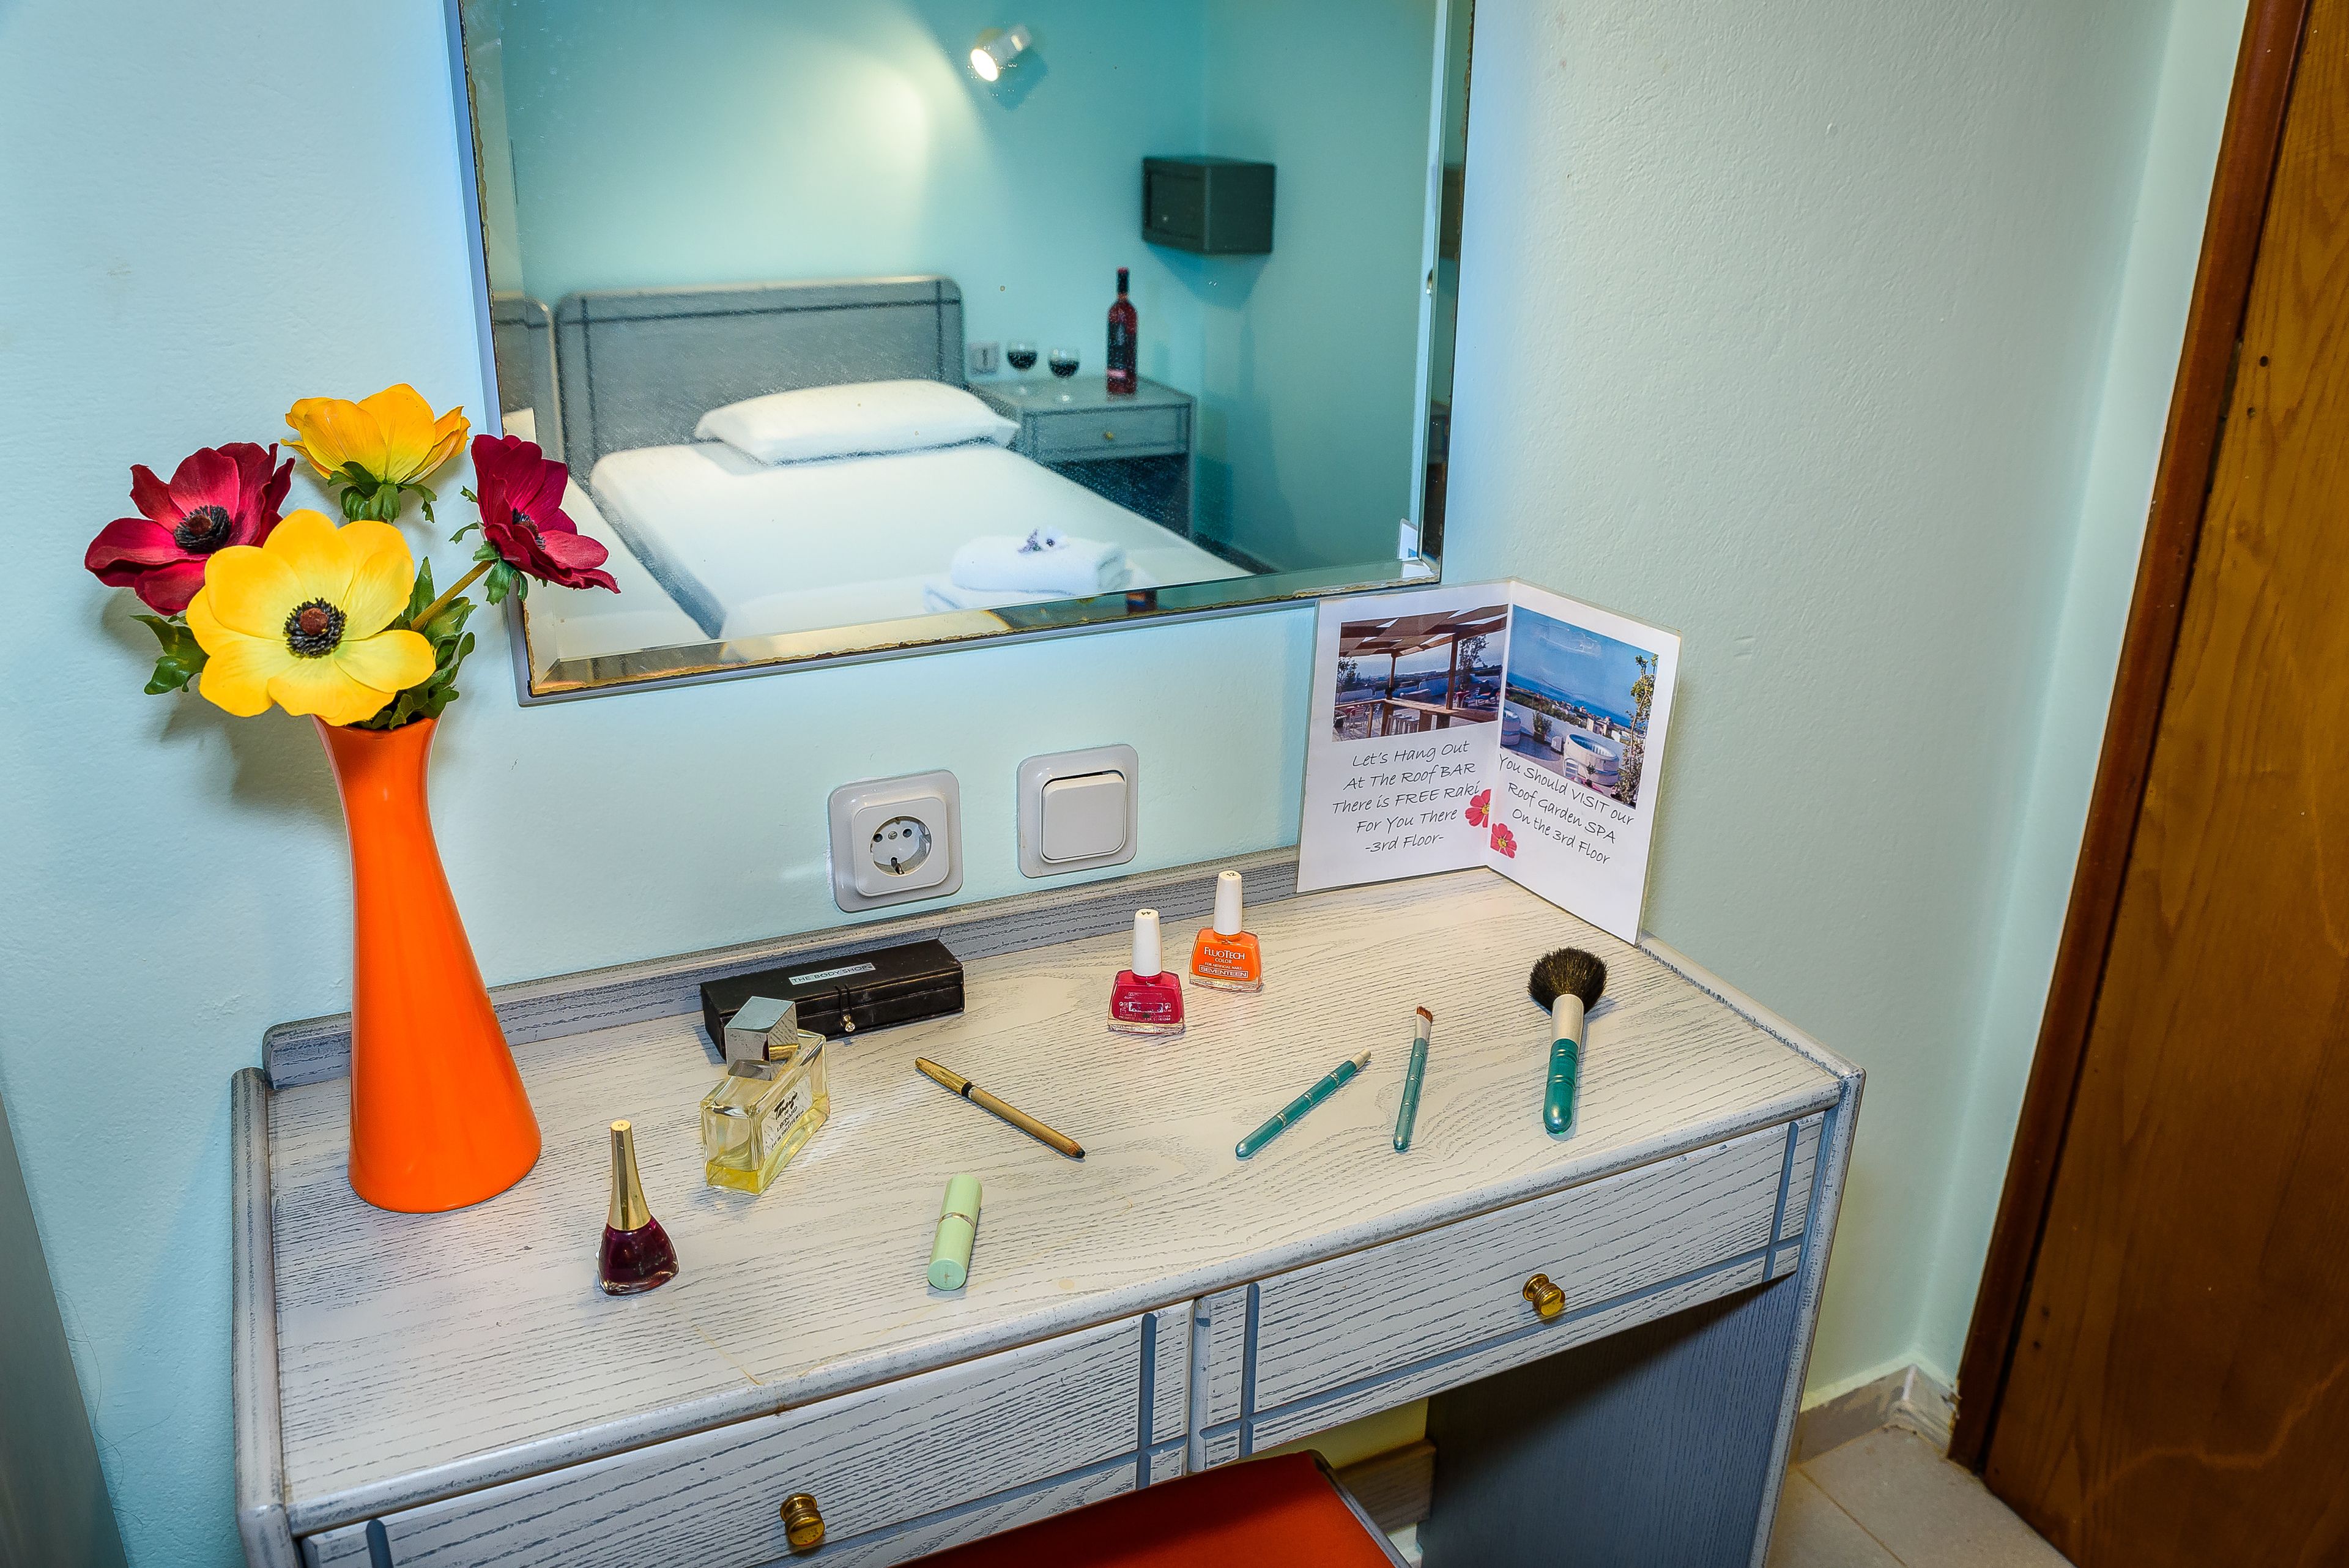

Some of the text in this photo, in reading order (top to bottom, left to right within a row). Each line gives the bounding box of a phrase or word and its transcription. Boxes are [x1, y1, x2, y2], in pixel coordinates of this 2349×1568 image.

[1353, 740, 1470, 767] Let's Hang Out
[1343, 764, 1475, 790] At The Roof BAR
[1499, 754, 1635, 825] You Should VISIT our
[1333, 781, 1480, 814] There is FREE Raki
[1356, 809, 1458, 834] For You There
[1508, 782, 1616, 844] Roof Garden SPA
[1365, 834, 1444, 852] -3rd Floor-
[1512, 809, 1611, 864] On the 3rd Floor
[1201, 967, 1247, 977] SEVENTEEN
[777, 1106, 798, 1132] LEONARD
